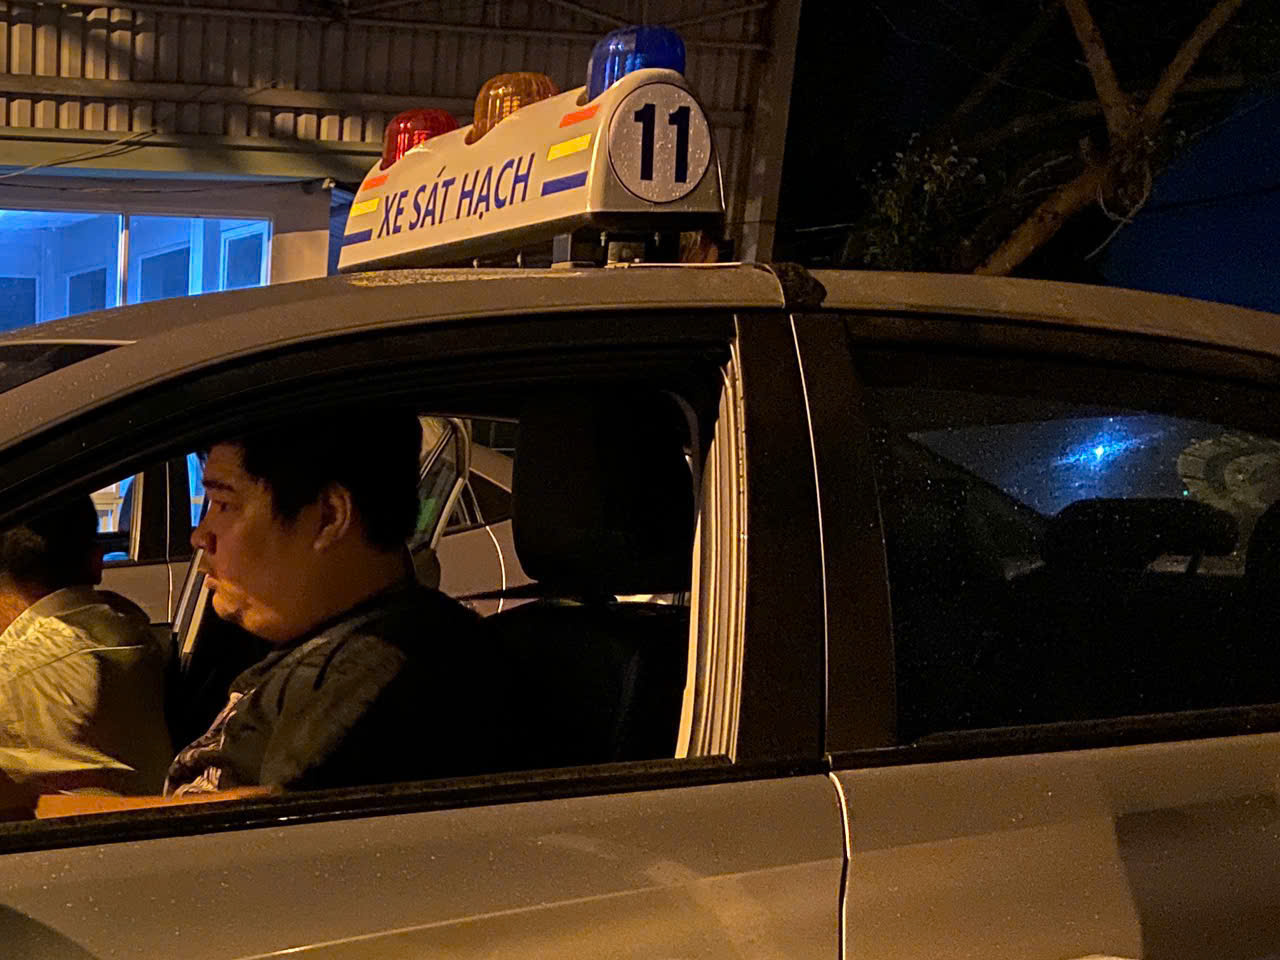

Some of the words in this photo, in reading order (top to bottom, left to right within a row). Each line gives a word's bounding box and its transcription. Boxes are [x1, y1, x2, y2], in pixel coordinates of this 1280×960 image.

[634, 103, 690, 184] 11
[378, 191, 408, 239] XE
[408, 166, 456, 231] SÁT
[456, 152, 535, 221] HẠCH
